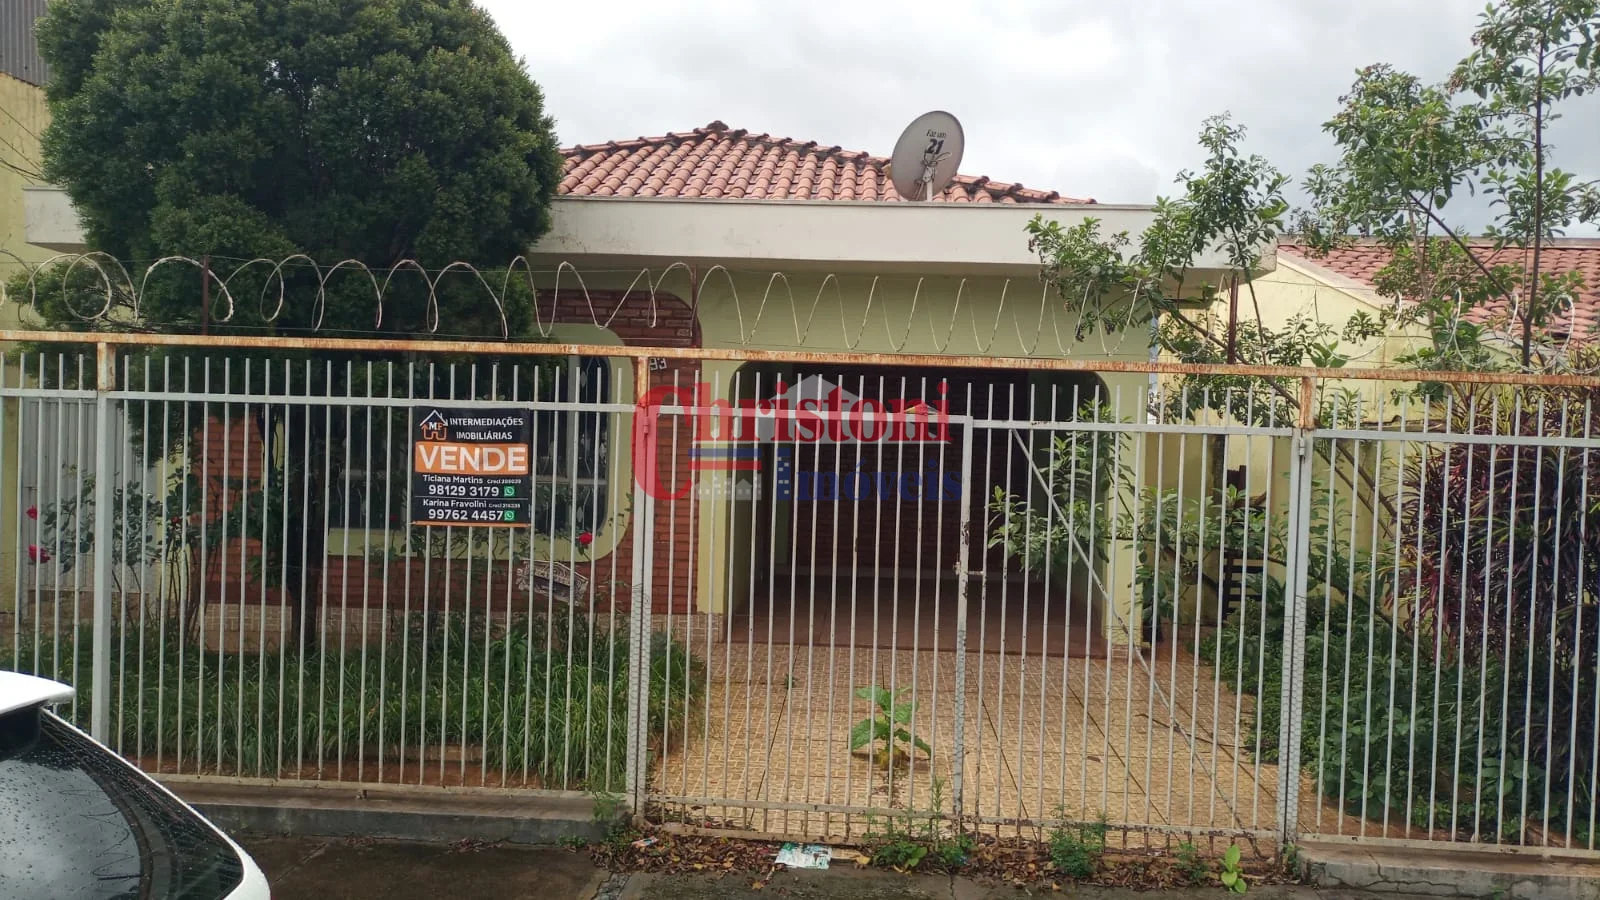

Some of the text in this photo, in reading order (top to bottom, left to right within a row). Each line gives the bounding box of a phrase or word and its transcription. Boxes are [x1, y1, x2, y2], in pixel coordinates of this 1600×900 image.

[926, 138, 944, 154] 21
[449, 417, 524, 428] INTERMEDIAÇÕES
[456, 430, 513, 440] IMOBILIÁRIAS
[418, 444, 527, 472] VENDE
[423, 474, 451, 483] Ticiana
[453, 476, 483, 484] Martins
[428, 485, 499, 497] 98129 3179
[423, 499, 449, 507] Karina
[451, 499, 487, 508] Fravolini
[428, 509, 503, 521] 99762 4457
